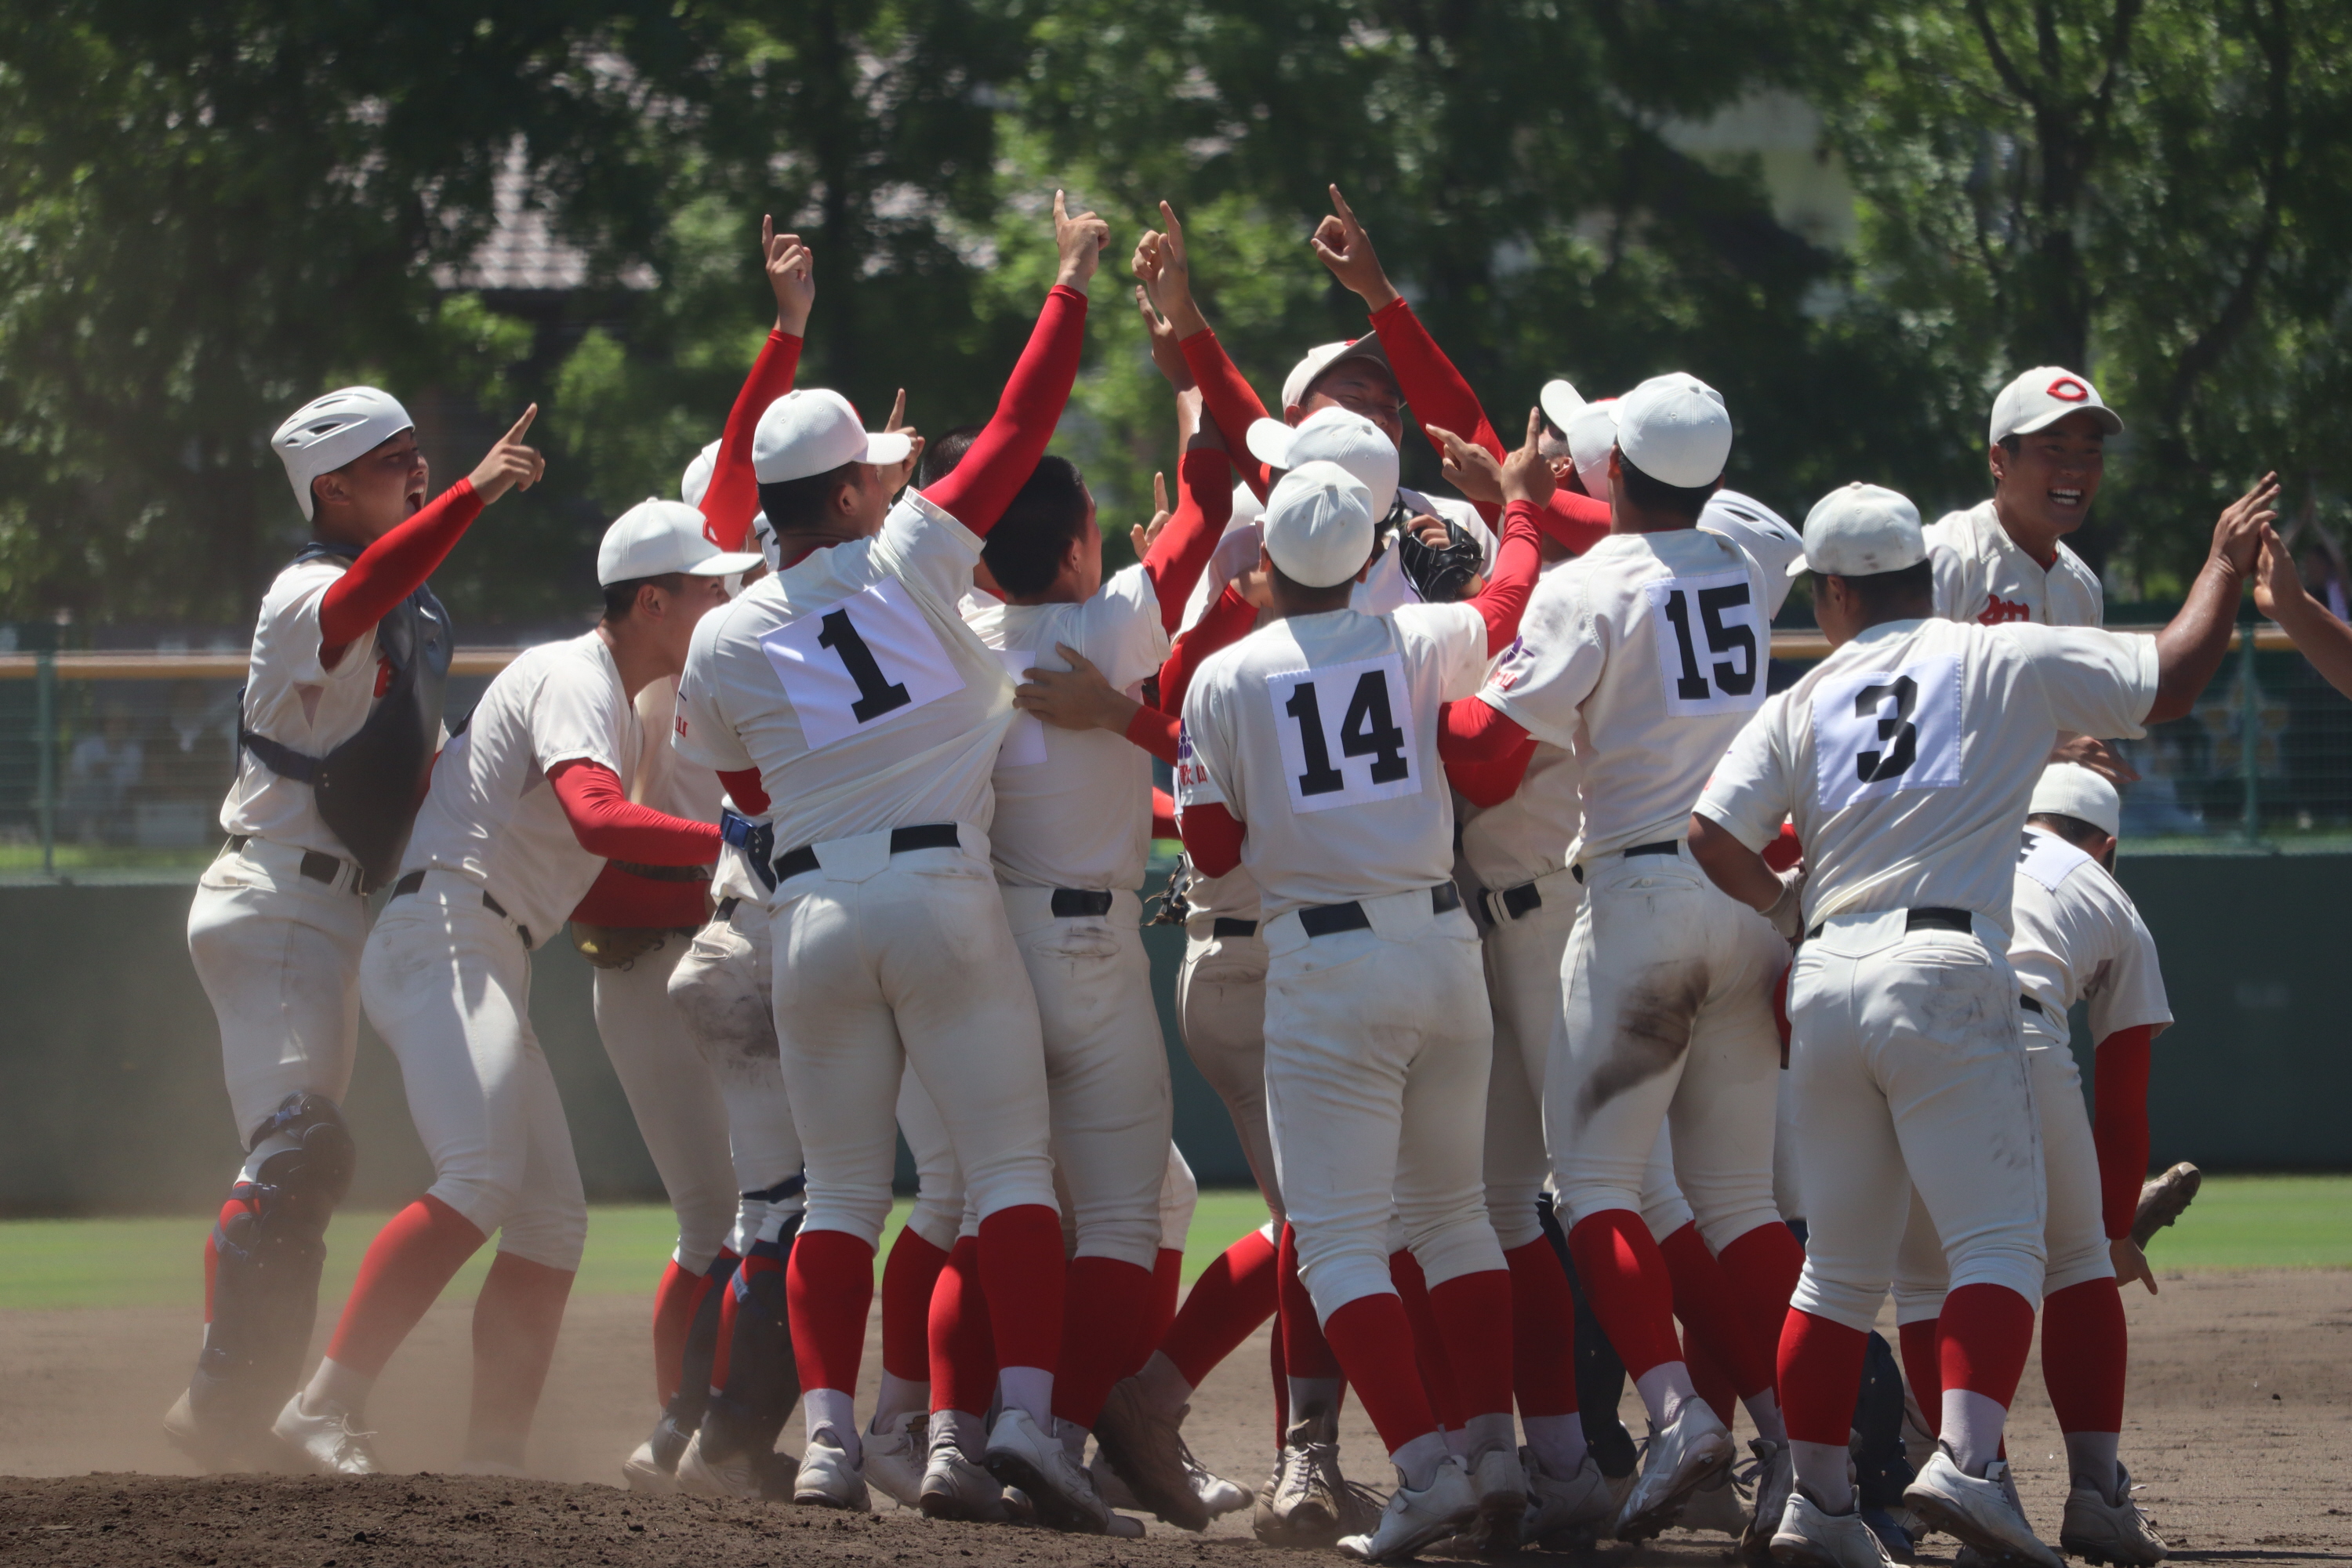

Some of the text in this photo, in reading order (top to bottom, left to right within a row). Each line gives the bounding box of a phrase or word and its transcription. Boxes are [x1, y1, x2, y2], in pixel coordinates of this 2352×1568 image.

[817, 607, 912, 724] 1
[1664, 582, 1757, 700] 15
[1285, 669, 1409, 797] 14
[1855, 675, 1918, 783] 3
